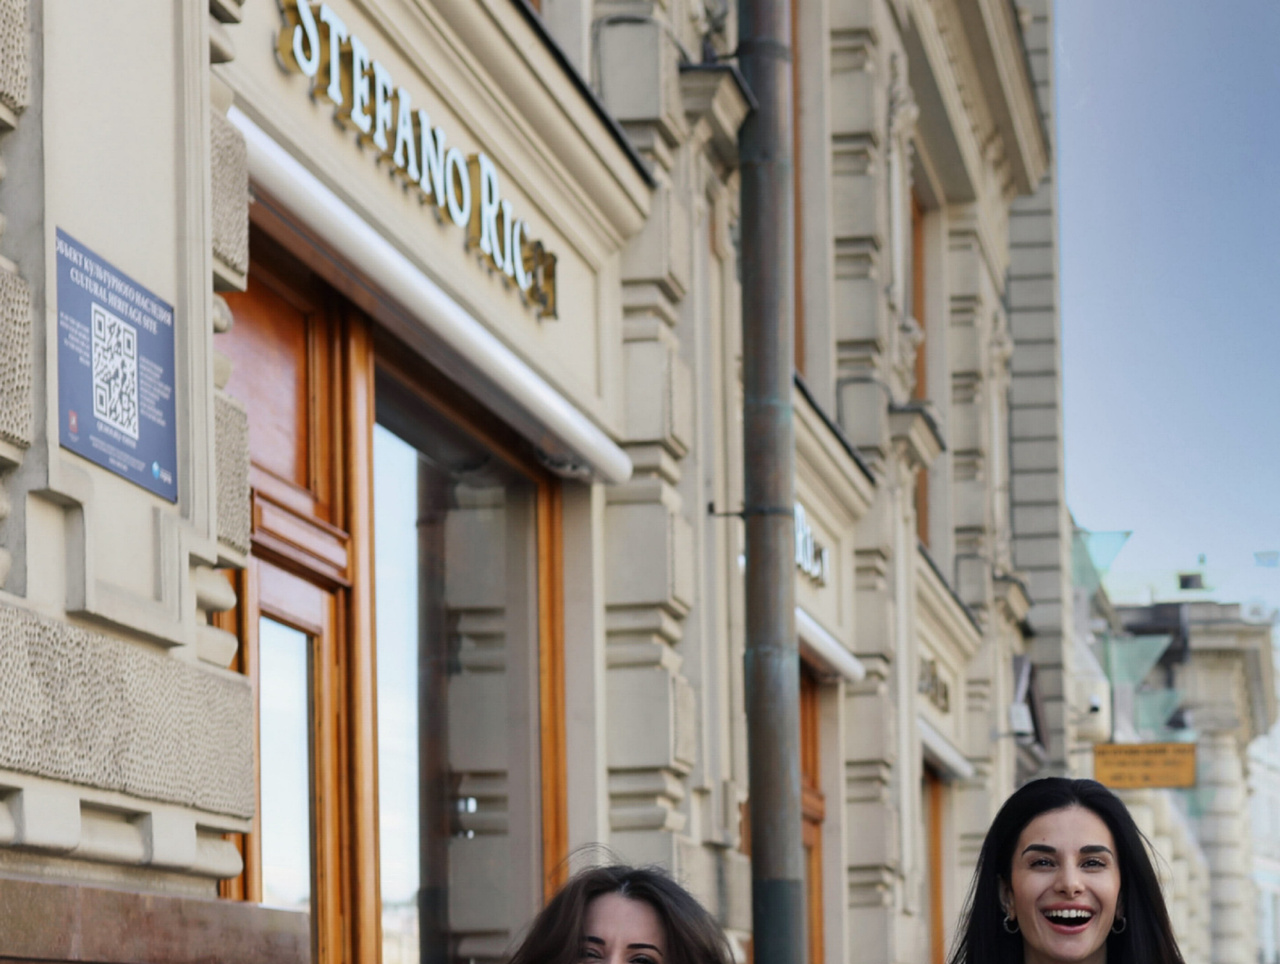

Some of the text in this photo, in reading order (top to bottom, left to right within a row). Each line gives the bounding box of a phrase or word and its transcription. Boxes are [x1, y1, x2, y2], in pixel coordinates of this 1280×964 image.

[291, 0, 472, 228] STEFANO
[69, 266, 158, 335] CULTURAL HERITAGE SITE
